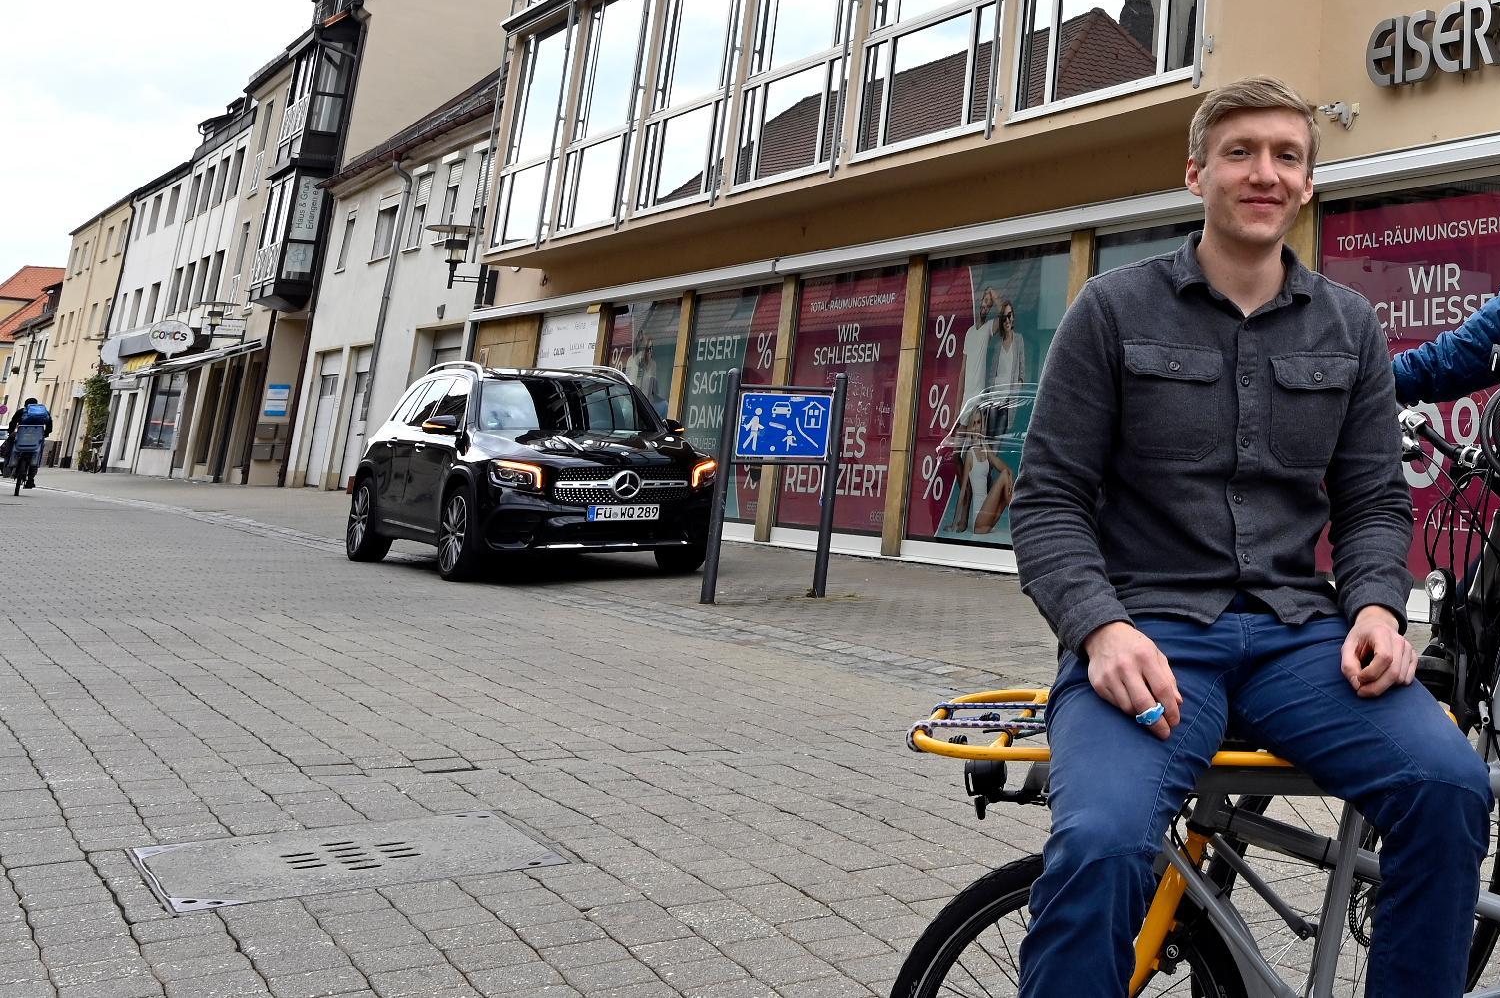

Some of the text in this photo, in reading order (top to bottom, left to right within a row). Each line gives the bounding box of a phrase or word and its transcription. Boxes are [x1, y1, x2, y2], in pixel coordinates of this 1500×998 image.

[1408, 263, 1461, 295] WIR
[1374, 293, 1495, 329] CHLIESS
[837, 323, 860, 344] WIR
[696, 334, 742, 362] EISERT
[813, 342, 881, 367] SCHLIESSEN
[691, 370, 728, 395] SAGT
[784, 464, 888, 498] REDZIERT
[595, 506, 659, 519] FÜ WQ 289
